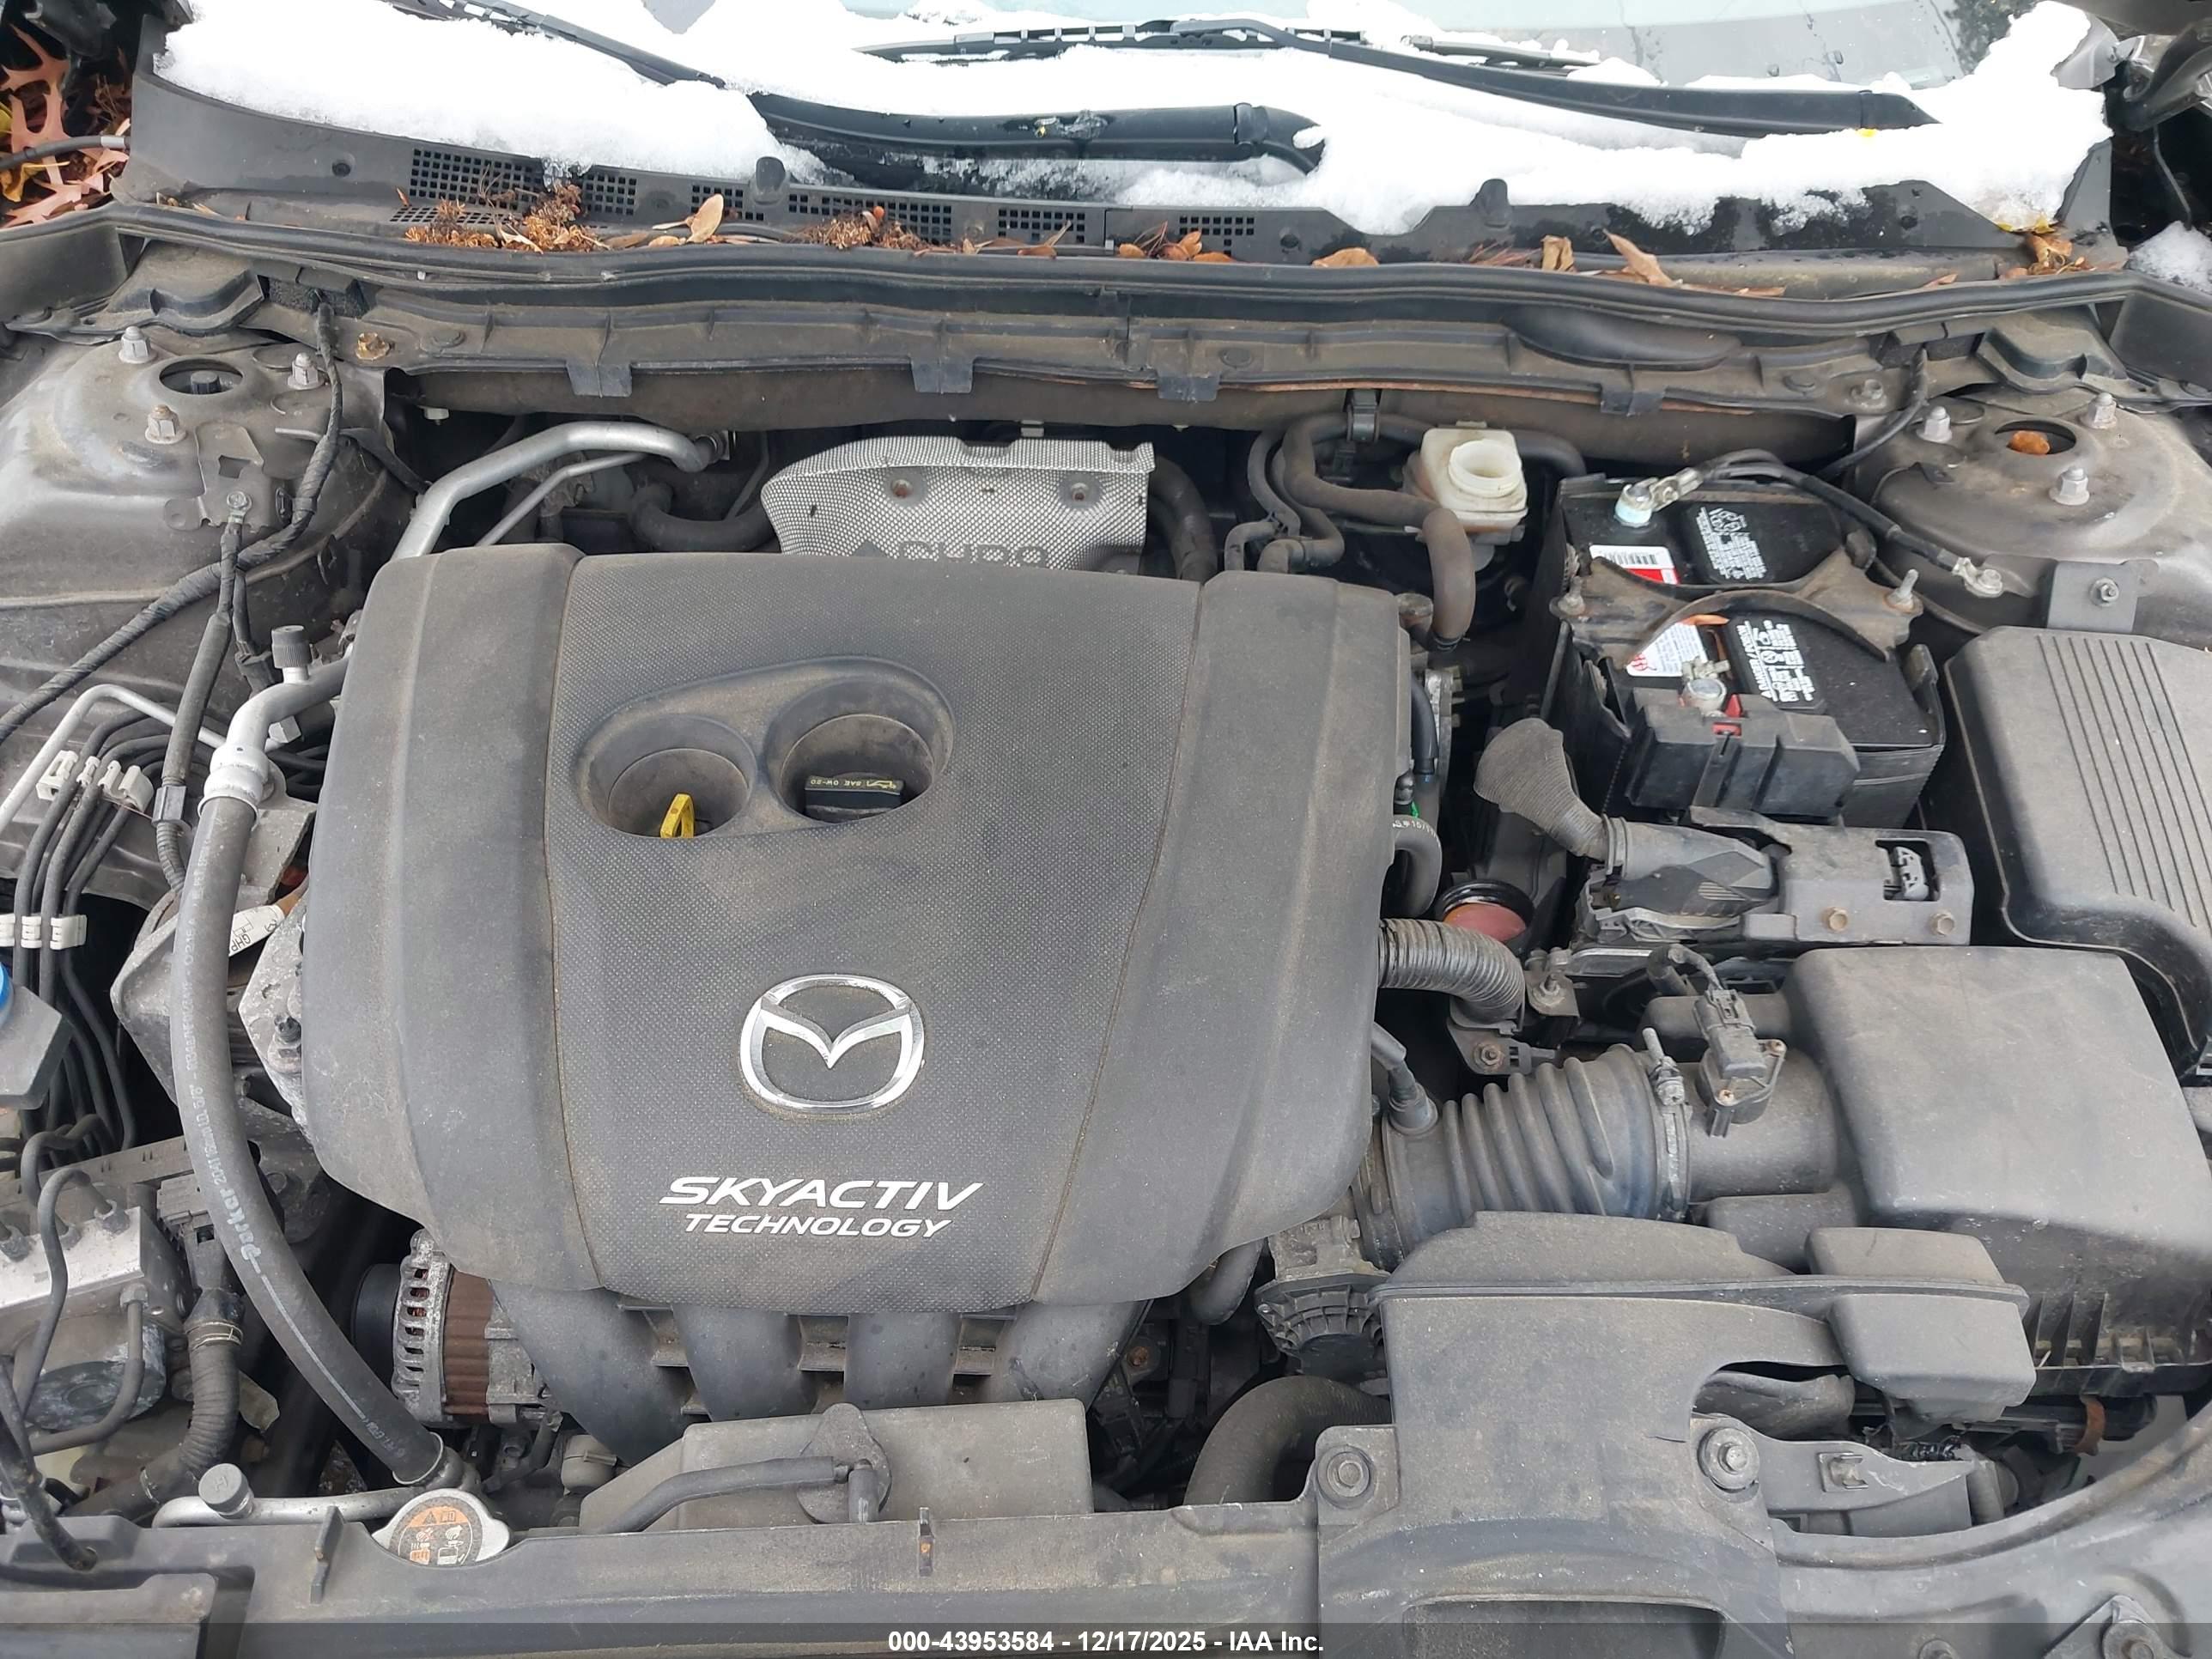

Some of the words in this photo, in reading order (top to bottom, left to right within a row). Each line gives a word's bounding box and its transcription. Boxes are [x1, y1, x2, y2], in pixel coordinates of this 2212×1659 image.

[659, 1176, 984, 1211] SKYACTIV
[219, 1188, 262, 1261] Parker
[685, 1213, 952, 1238] TECHNOLOGY
